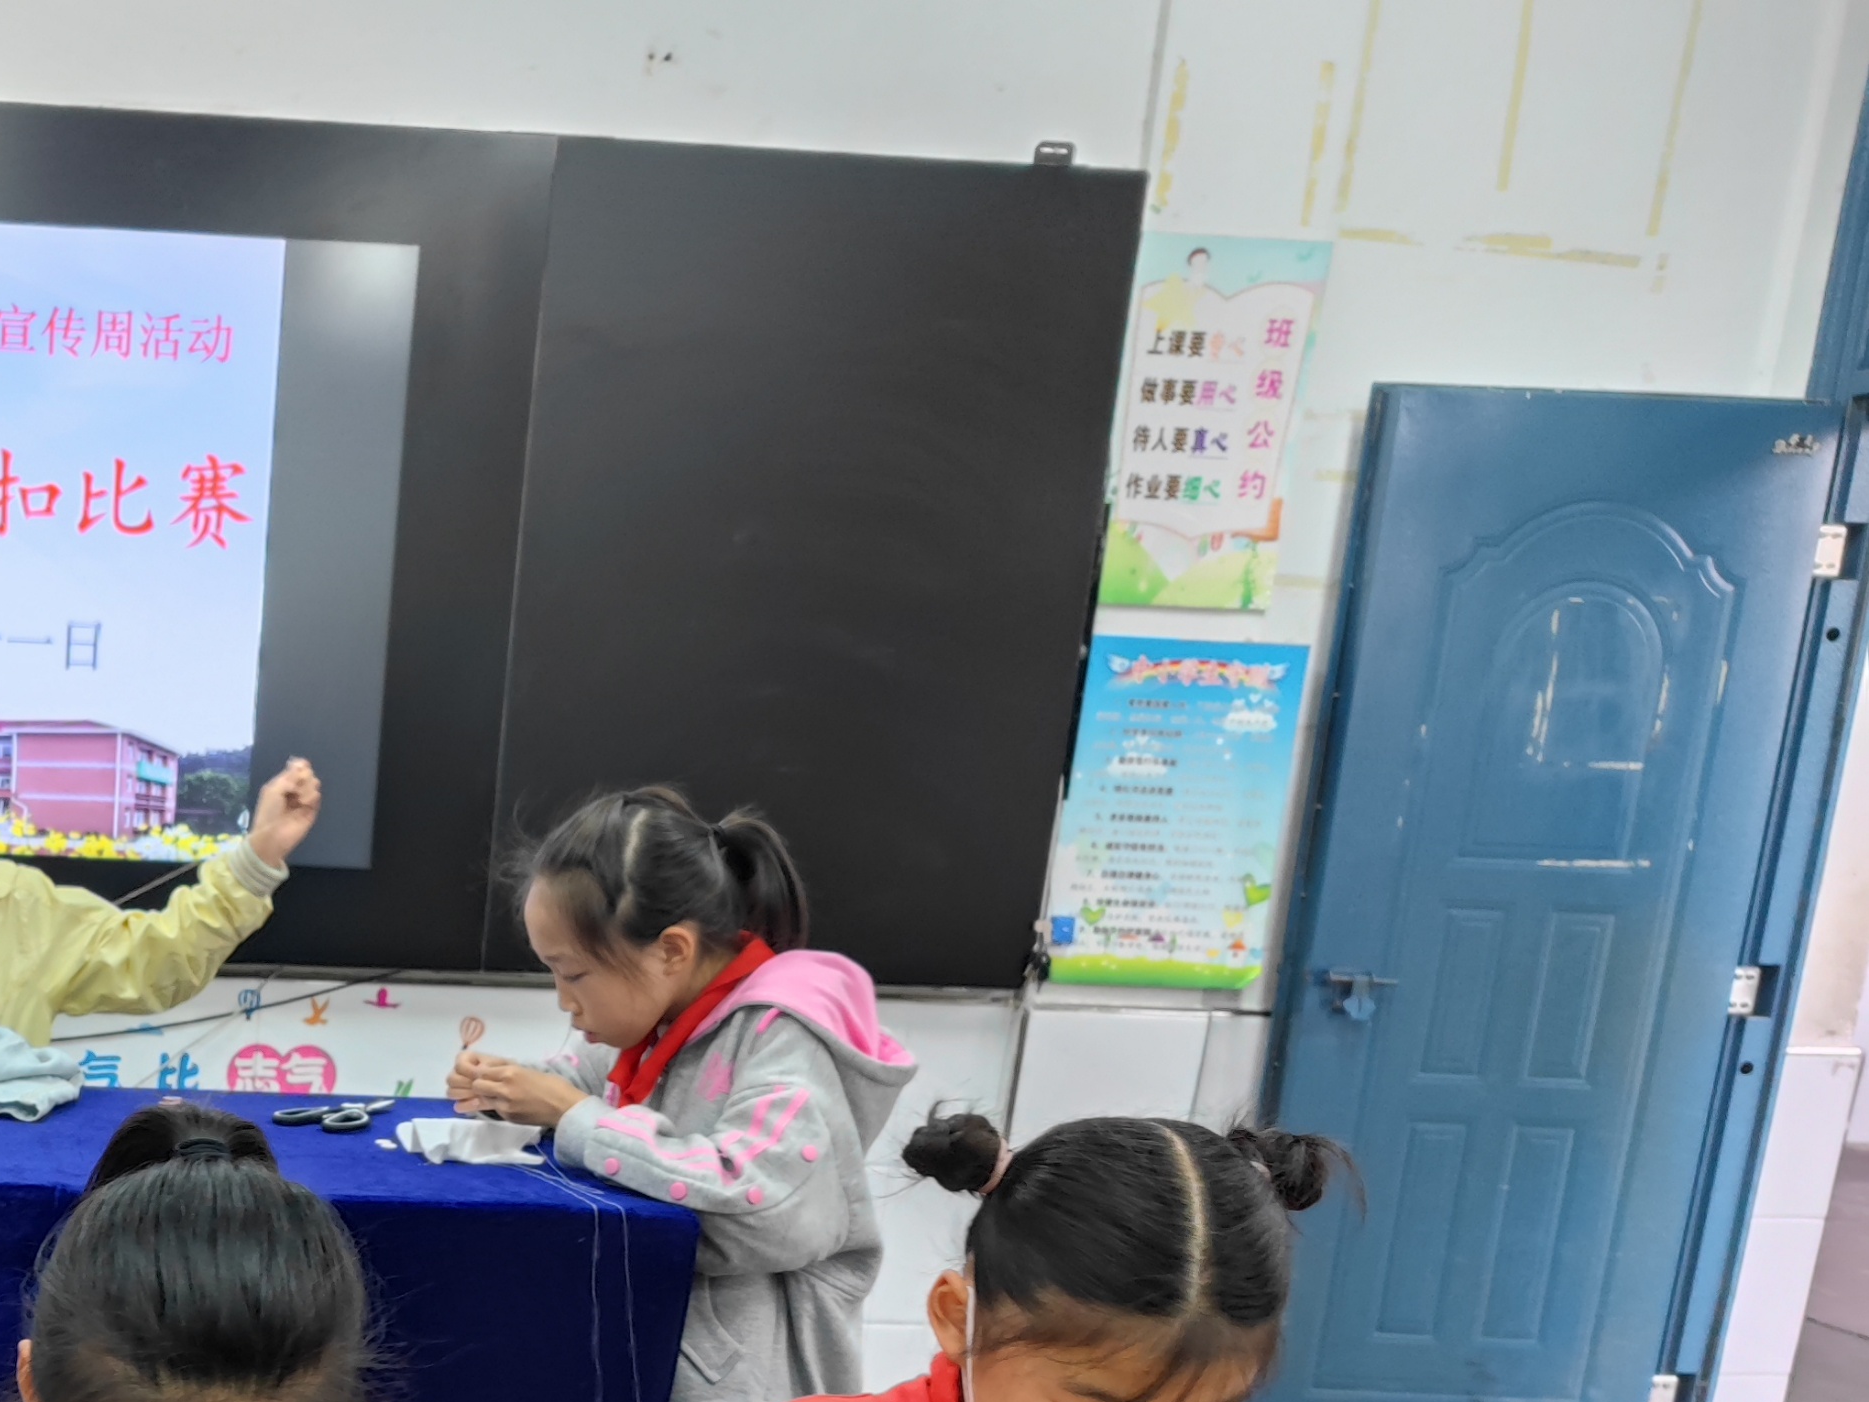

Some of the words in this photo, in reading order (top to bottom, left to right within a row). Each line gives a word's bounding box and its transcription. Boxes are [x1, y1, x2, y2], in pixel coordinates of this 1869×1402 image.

[1141, 377, 1236, 405] 做事要用心
[1237, 318, 1295, 501] 班级公约
[1133, 425, 1228, 453] 待人要真心
[158, 1053, 200, 1090] 比
[234, 1051, 328, 1094] 志气
